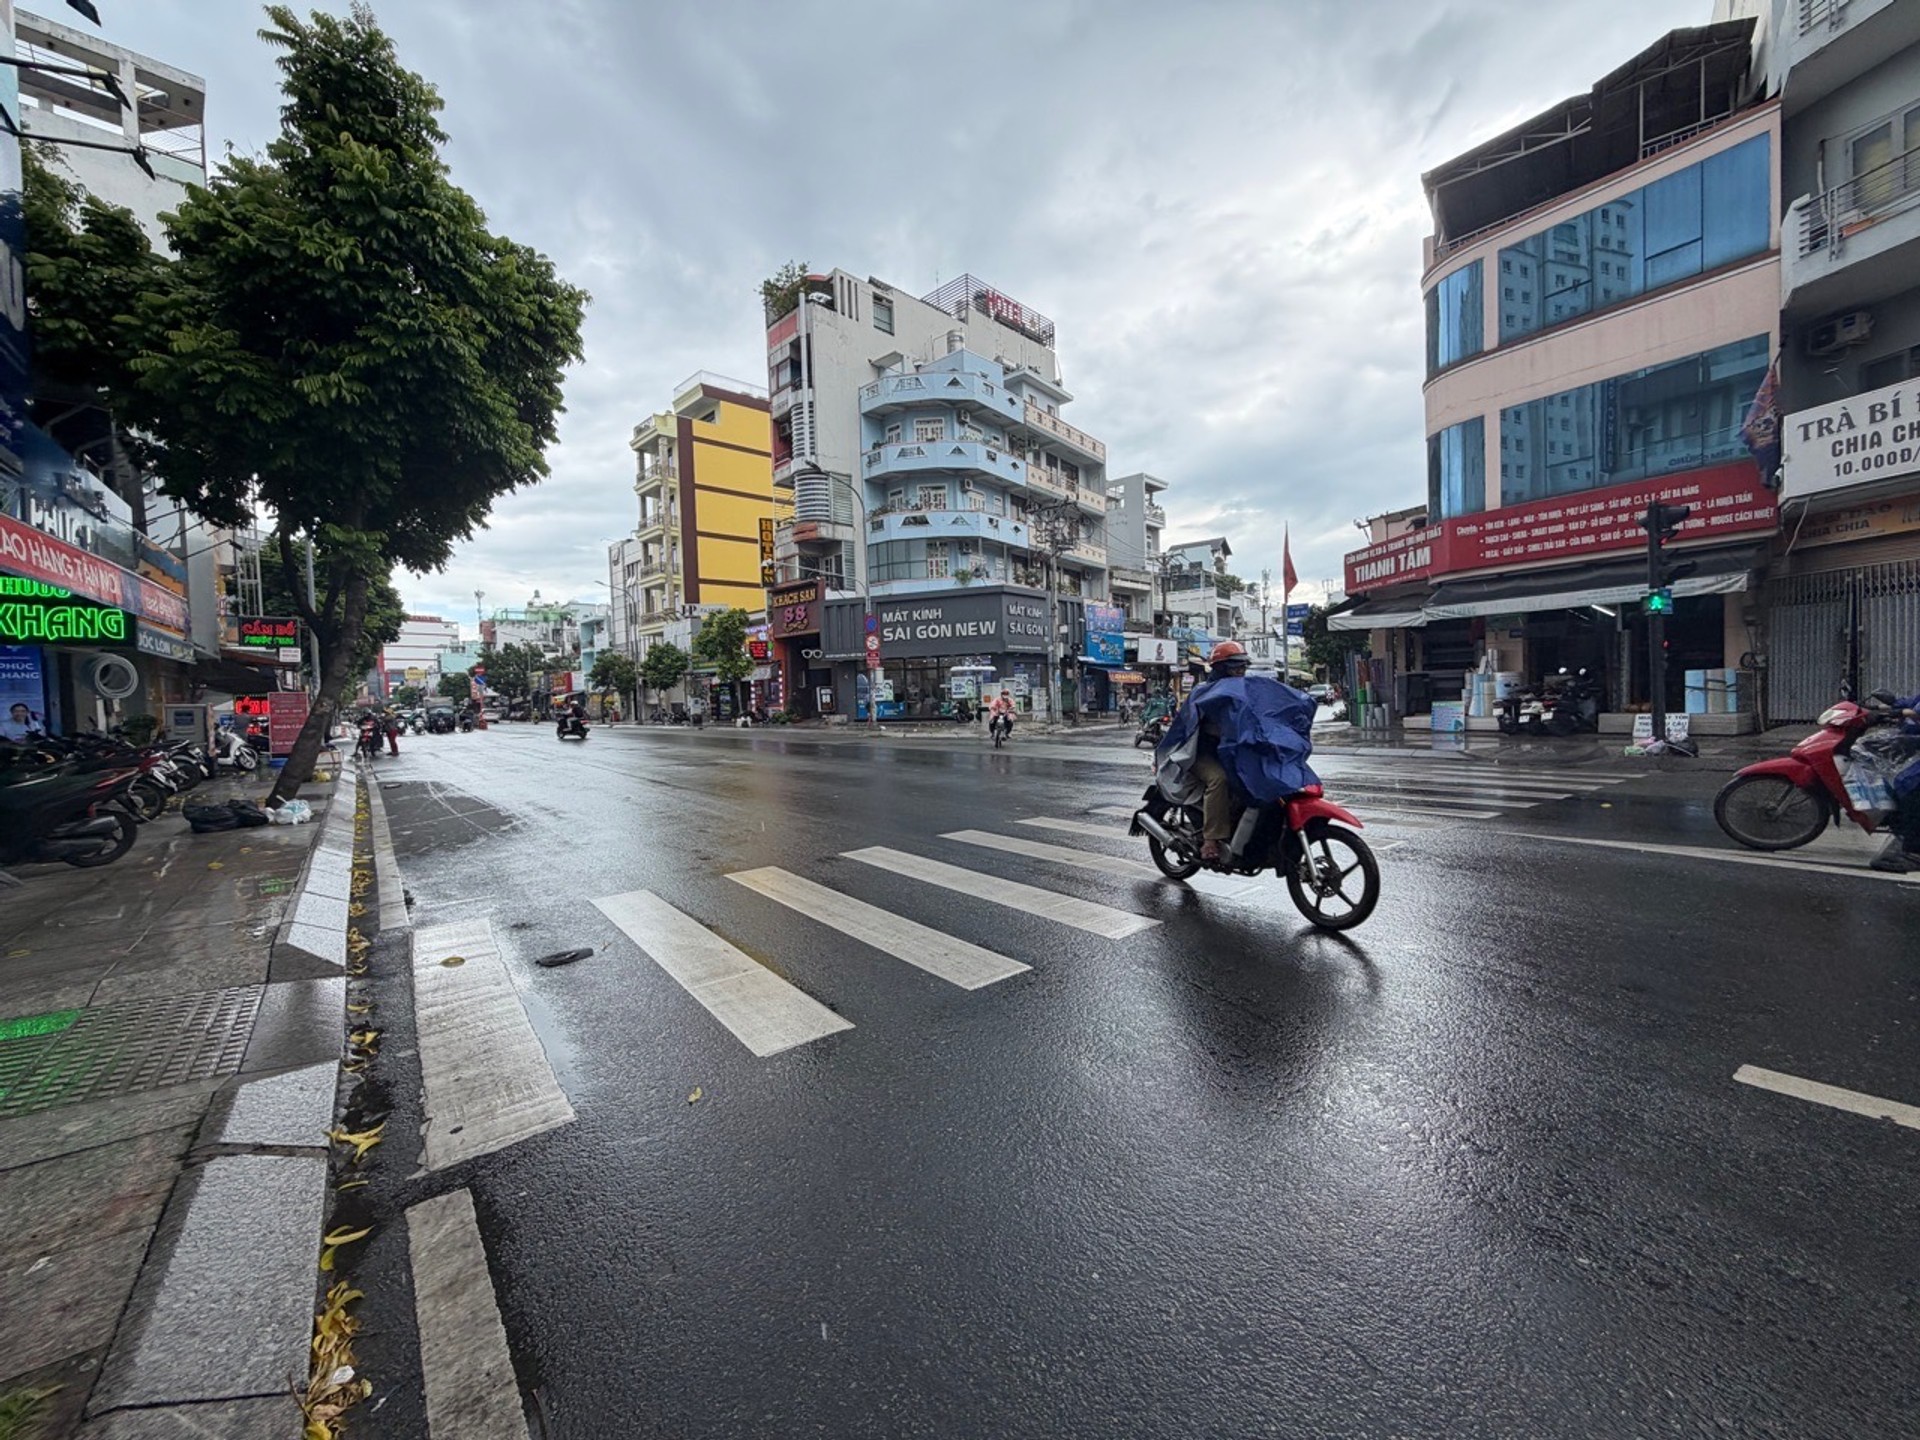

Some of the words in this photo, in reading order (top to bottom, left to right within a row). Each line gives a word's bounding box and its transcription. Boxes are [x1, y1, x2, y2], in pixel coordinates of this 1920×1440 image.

[986, 290, 1023, 325] HOTEL
[1797, 406, 1857, 442] TRÀ
[1868, 390, 1902, 425] BÍ
[1831, 431, 1882, 458] CHIA
[1836, 519, 1870, 534] CHIA
[28, 535, 74, 579] HÀNG
[1354, 557, 1395, 583] THANH
[1398, 546, 1431, 572] TÂM
[883, 625, 911, 642] SÀI
[916, 622, 952, 639] GÒN
[955, 620, 997, 637] NEW
